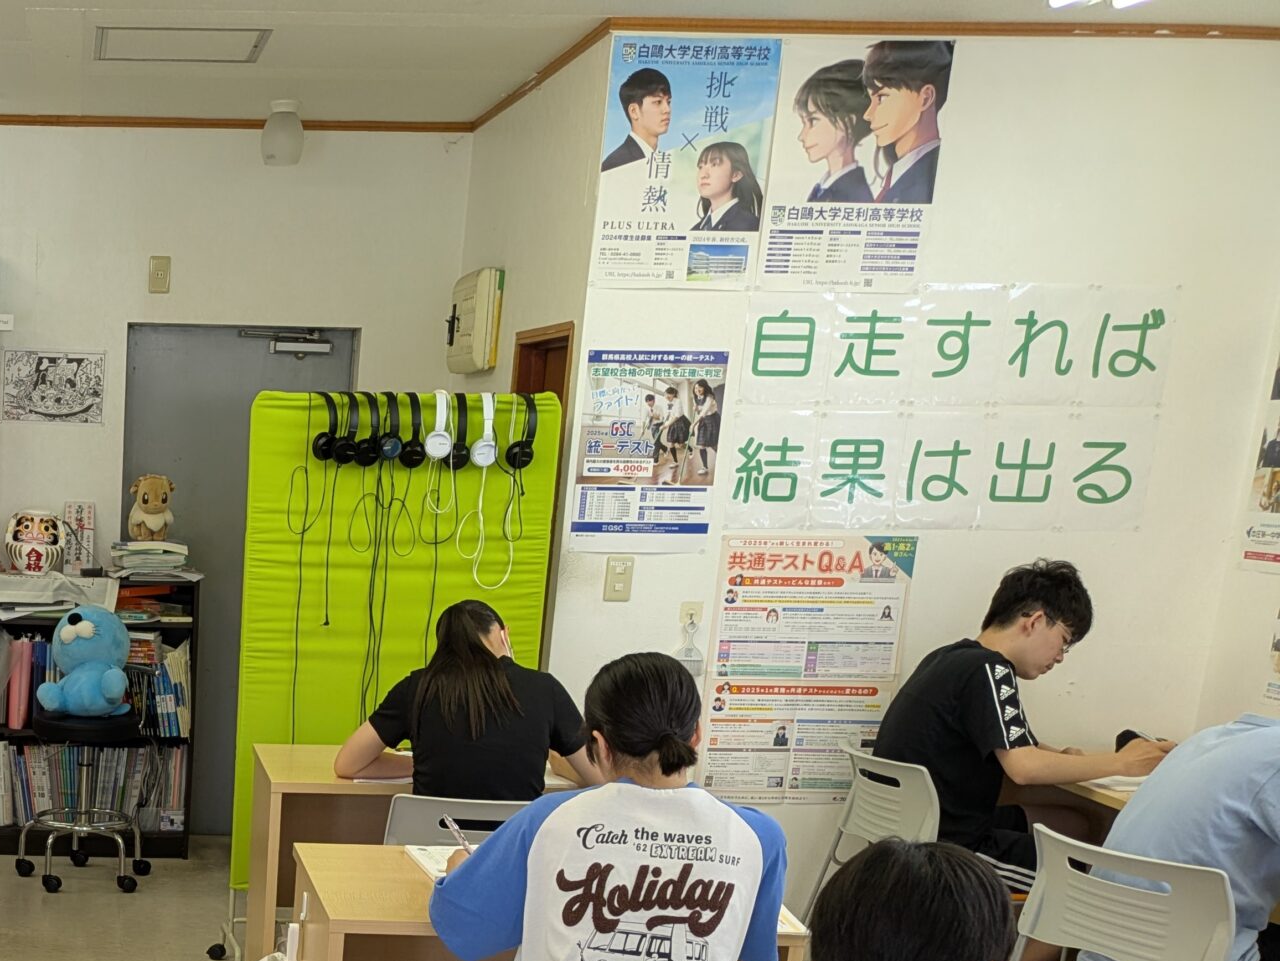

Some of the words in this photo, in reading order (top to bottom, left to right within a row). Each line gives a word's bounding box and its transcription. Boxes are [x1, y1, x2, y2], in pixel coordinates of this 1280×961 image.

[641, 150, 672, 213] 情熱
[602, 221, 632, 231] PLUS
[638, 221, 675, 231] ULTRA
[751, 308, 1166, 378] 自走すれば
[592, 367, 721, 378] 志望校合格の可能性を正確に判定
[610, 421, 634, 437] GSC
[587, 439, 655, 454] 統一テスト
[613, 465, 648, 473] 4,000円
[732, 436, 1133, 505] 結果は出る
[25, 547, 43, 572] 合格
[576, 823, 629, 850] Catch
[634, 827, 659, 841] the
[663, 830, 712, 845] waves
[650, 843, 717, 862] EXTREAM
[718, 854, 741, 866] SURF
[555, 862, 735, 937] Holiday
